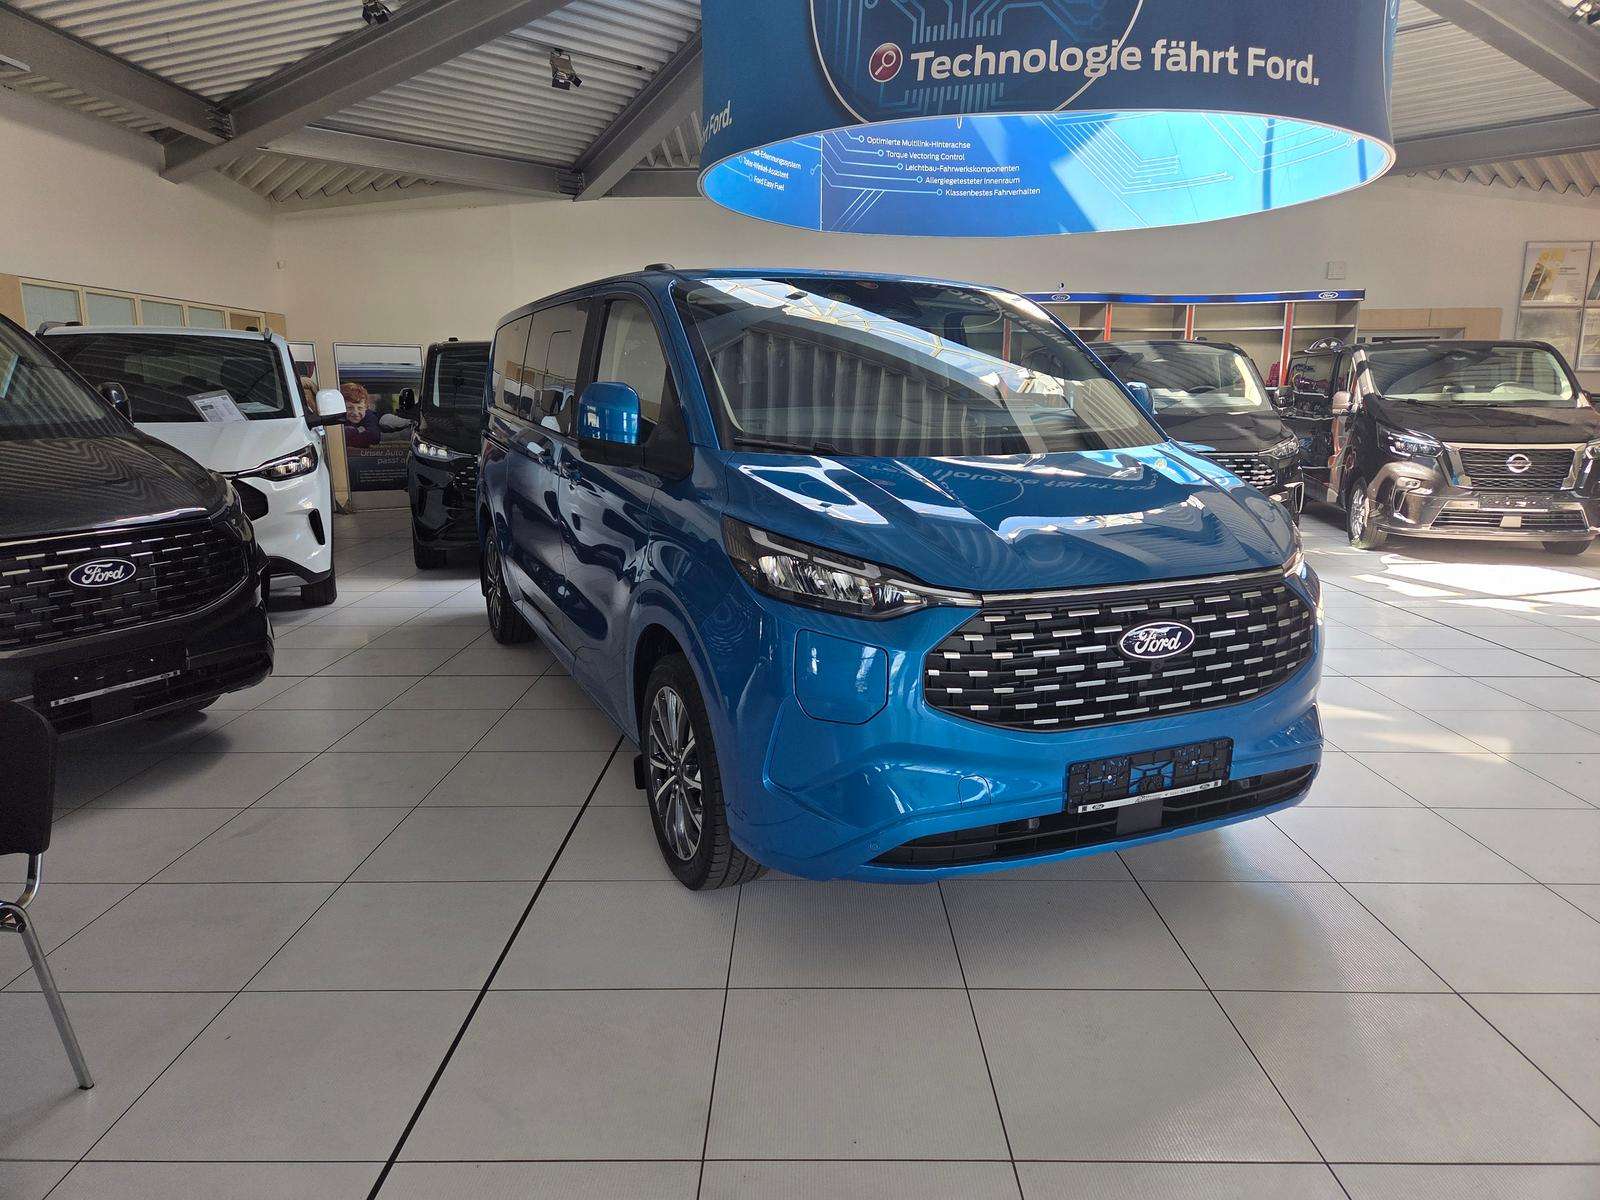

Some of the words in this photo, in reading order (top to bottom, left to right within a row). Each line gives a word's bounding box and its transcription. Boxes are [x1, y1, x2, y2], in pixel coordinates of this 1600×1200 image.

[911, 39, 1142, 82] Technologie
[1150, 39, 1239, 76] fährt
[1247, 47, 1320, 87] Ford.
[866, 136, 901, 147] Optimierte
[901, 138, 971, 149] Multilink-Hinterachse
[886, 150, 908, 160] Torque
[909, 151, 940, 162] Vectoring
[940, 152, 966, 161] Control
[905, 164, 1020, 174] Leichtbau-Fahrwerkskomponenten
[753, 175, 764, 185] Ford
[763, 178, 775, 190] Easy
[774, 181, 785, 192] Fuel
[925, 176, 983, 186] Allergiegetesteter
[983, 177, 1021, 185] Innenraum
[945, 188, 993, 197] Klassenbestes
[993, 186, 1041, 197] Fahrverhalten
[81, 563, 125, 584] Ford
[1134, 628, 1182, 654] Ford
